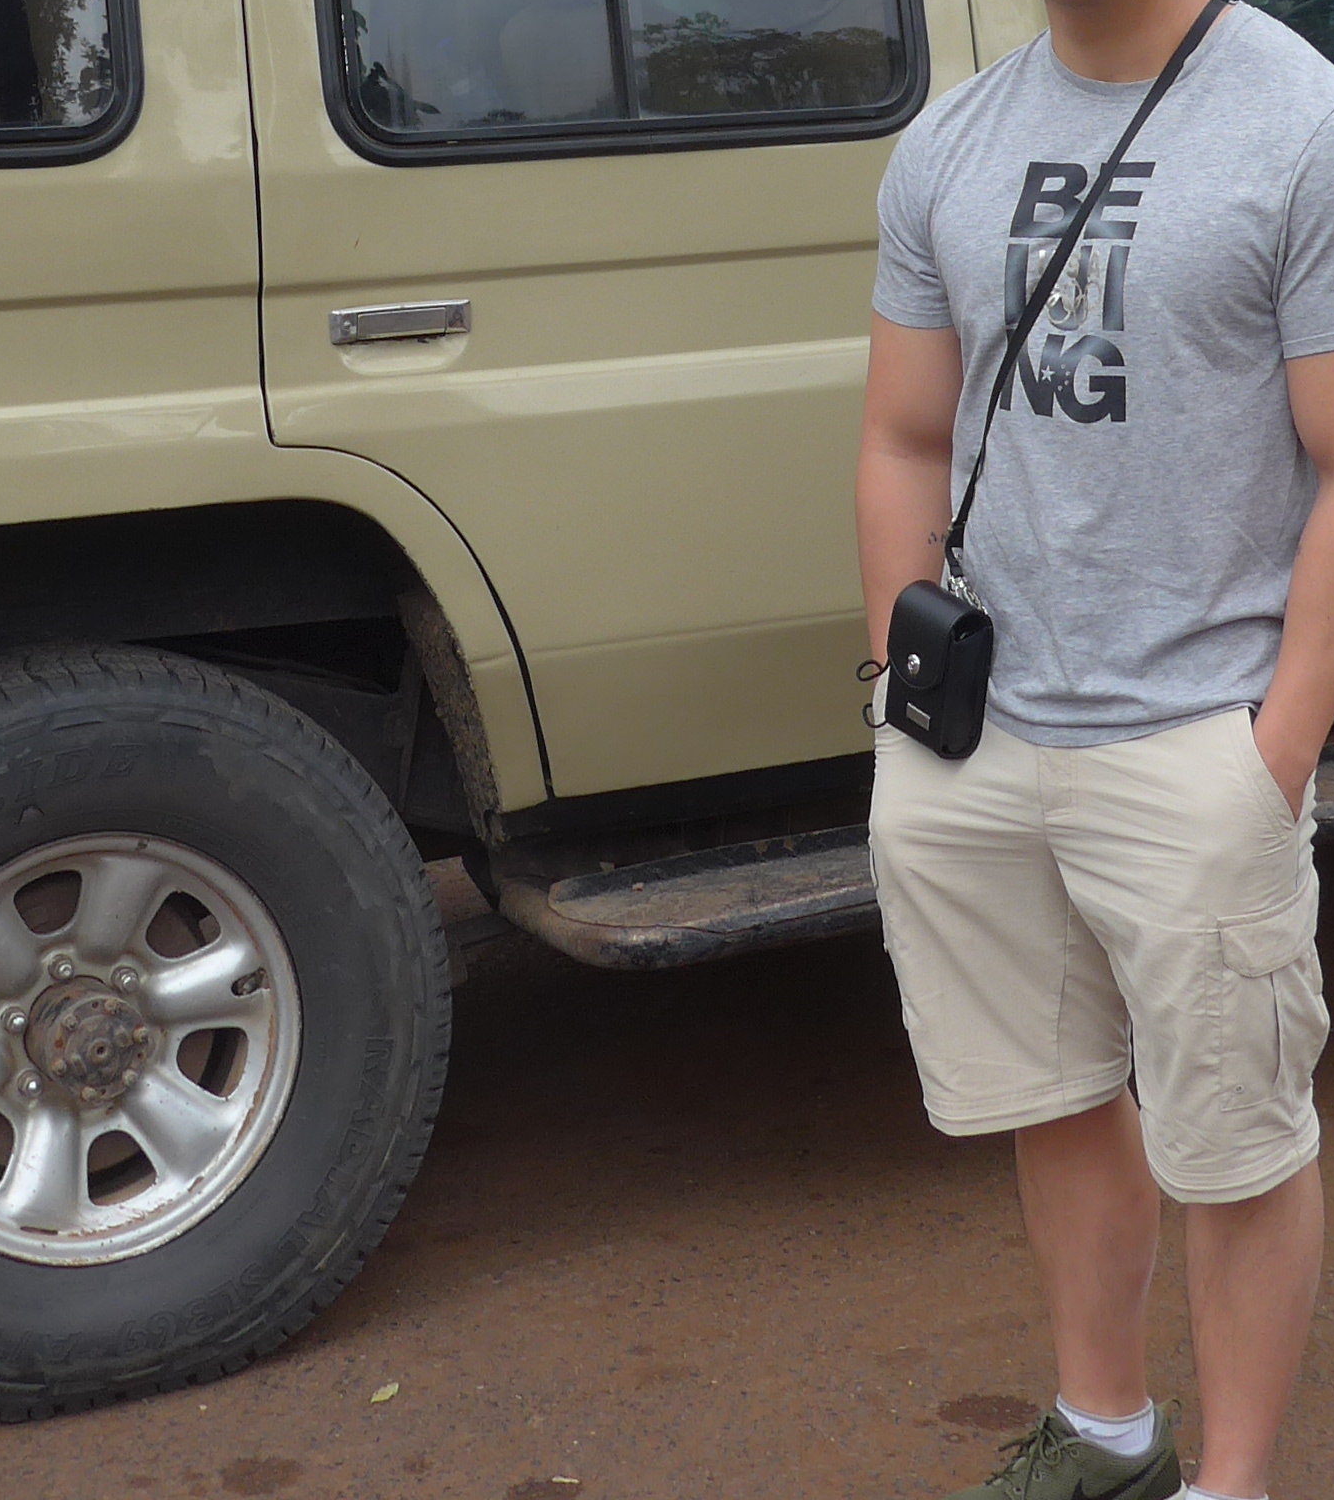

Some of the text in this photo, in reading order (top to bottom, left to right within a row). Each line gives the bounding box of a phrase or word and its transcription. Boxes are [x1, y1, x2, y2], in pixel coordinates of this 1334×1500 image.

[1009, 161, 1156, 240] BE
[999, 334, 1127, 424] NG
[275, 1036, 394, 1259] RADIAL
